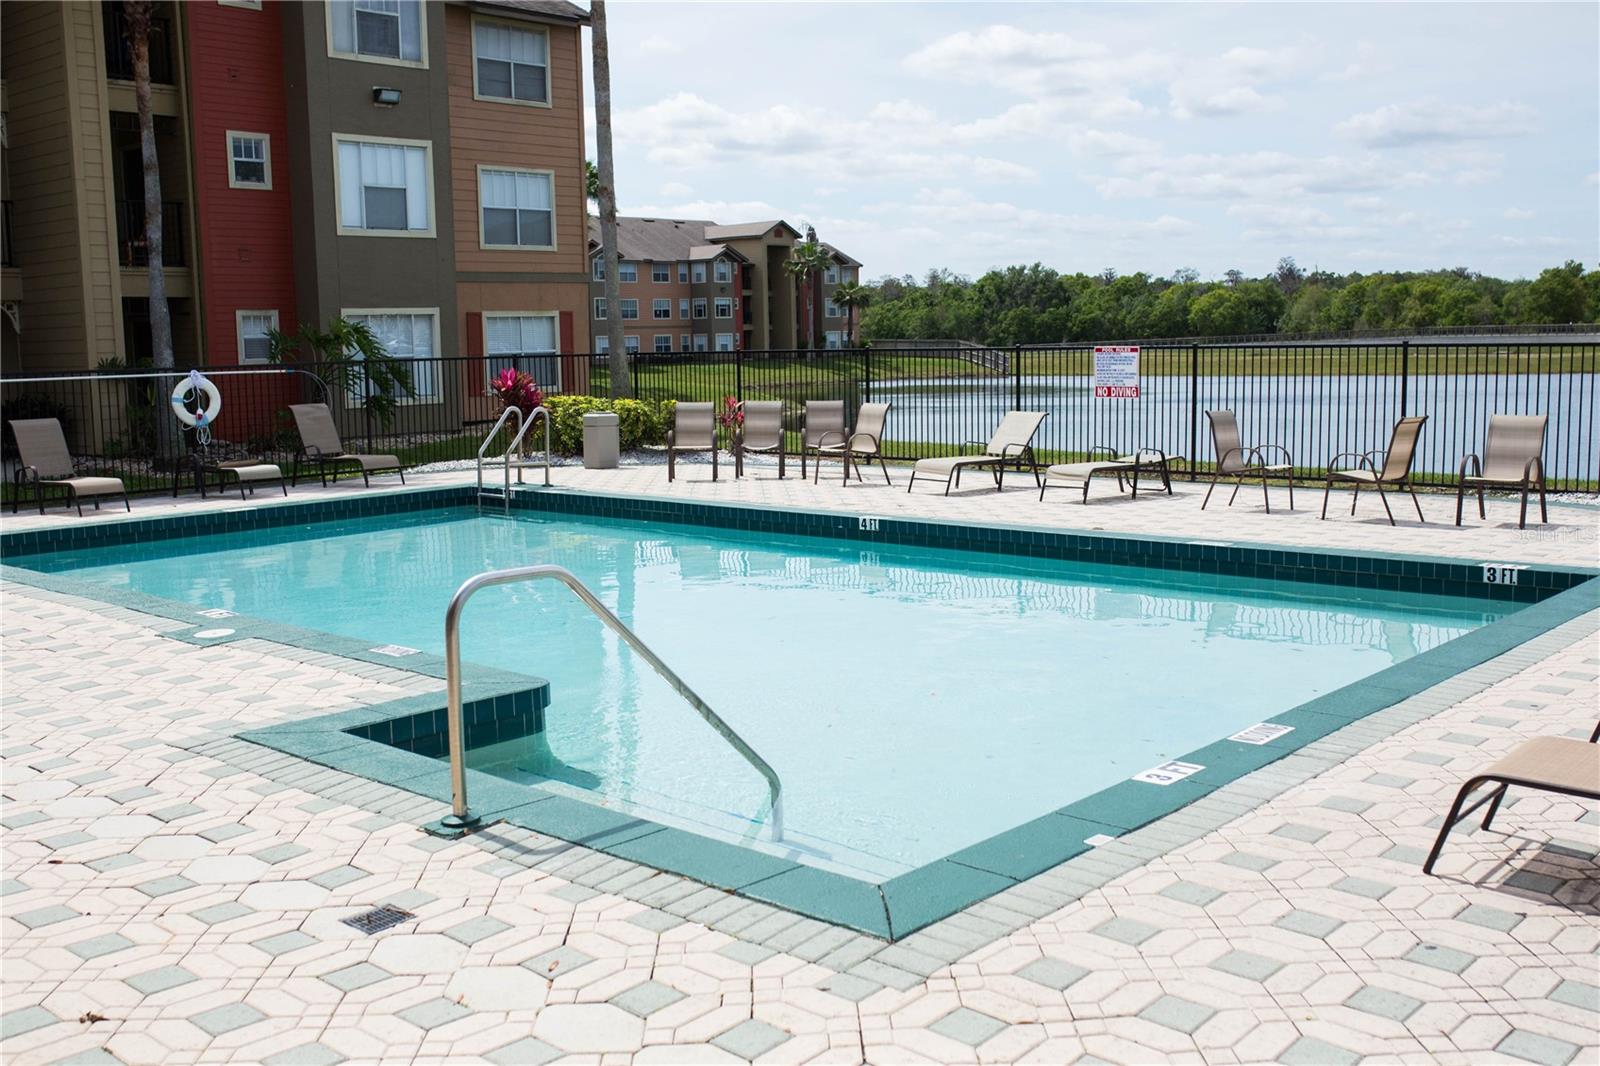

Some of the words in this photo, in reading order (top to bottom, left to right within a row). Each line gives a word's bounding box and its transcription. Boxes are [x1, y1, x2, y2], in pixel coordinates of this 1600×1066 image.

[1097, 387, 1108, 397] NO
[1111, 387, 1137, 397] DIVING
[861, 518, 868, 530] 4
[1487, 567, 1497, 582] 3
[1157, 762, 1199, 775] FT
[1145, 773, 1172, 781] 3
